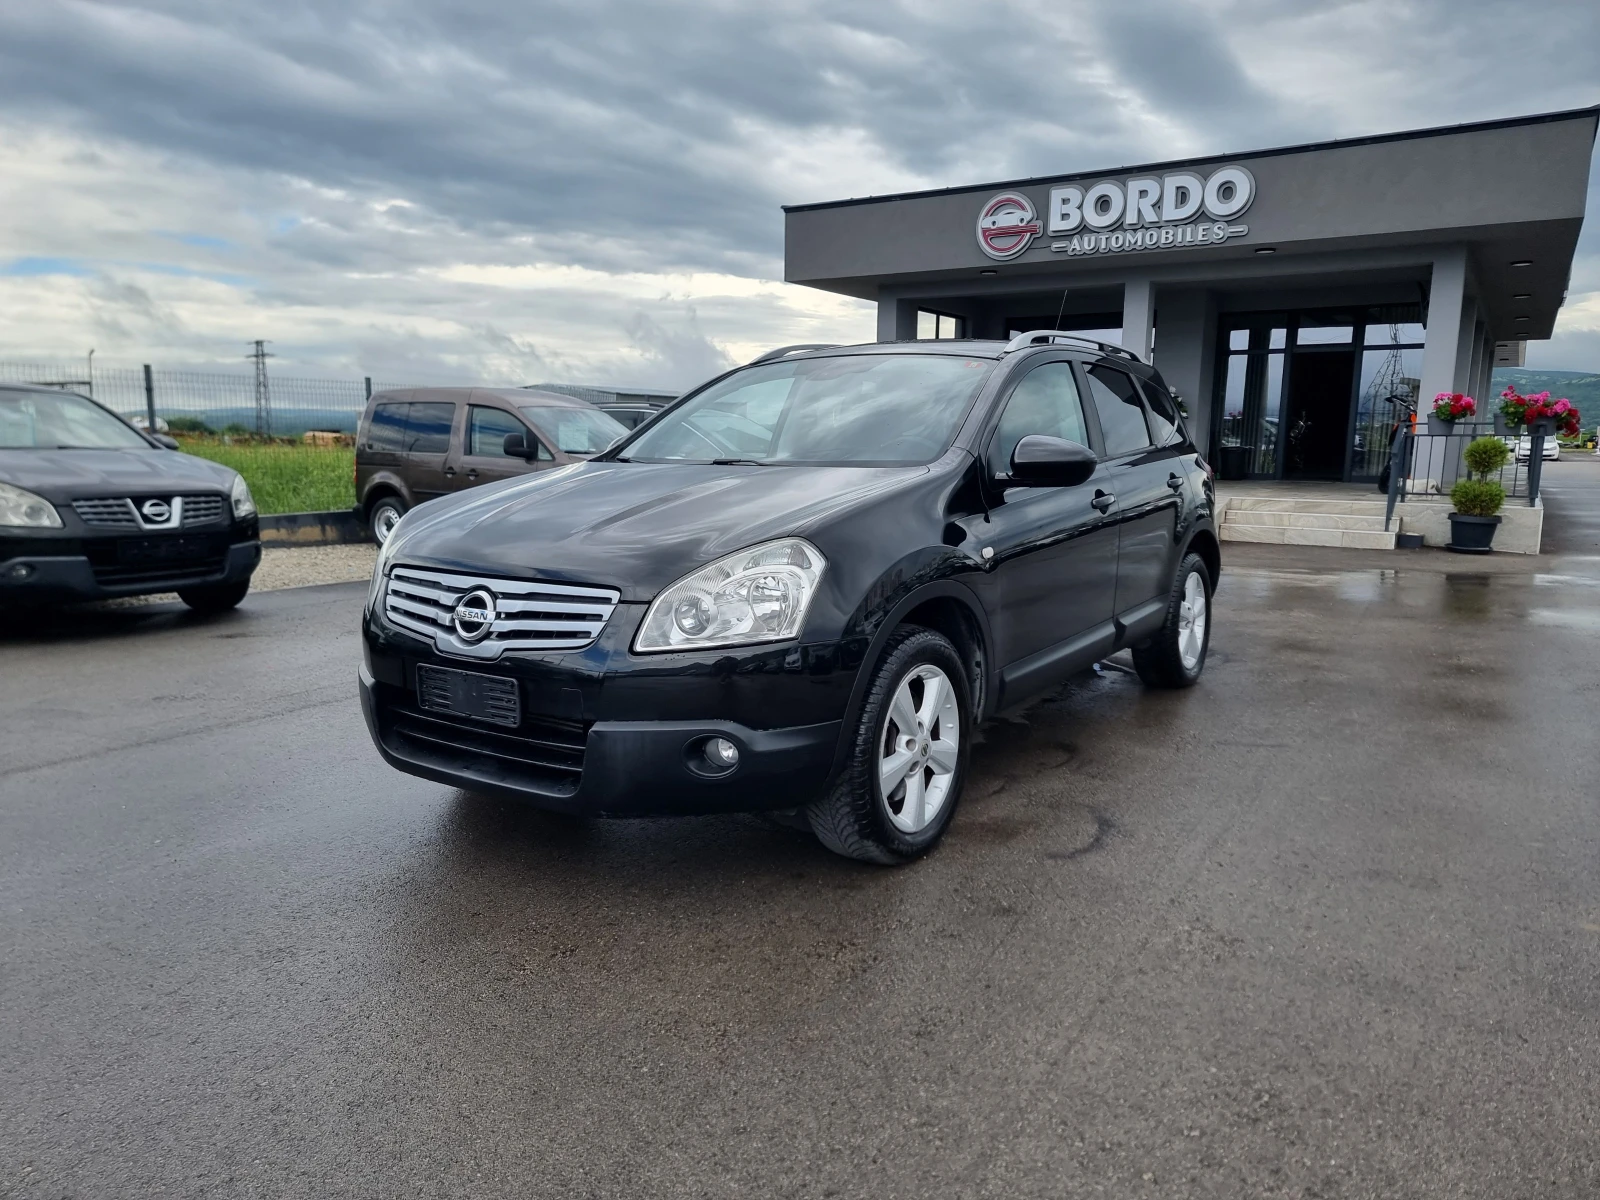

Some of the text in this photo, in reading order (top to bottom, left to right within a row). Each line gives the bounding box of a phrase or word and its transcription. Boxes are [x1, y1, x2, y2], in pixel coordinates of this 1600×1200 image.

[1050, 168, 1251, 232] BORDO
[1069, 224, 1225, 251] AUTOMOBILES
[455, 608, 488, 621] NISSAN
